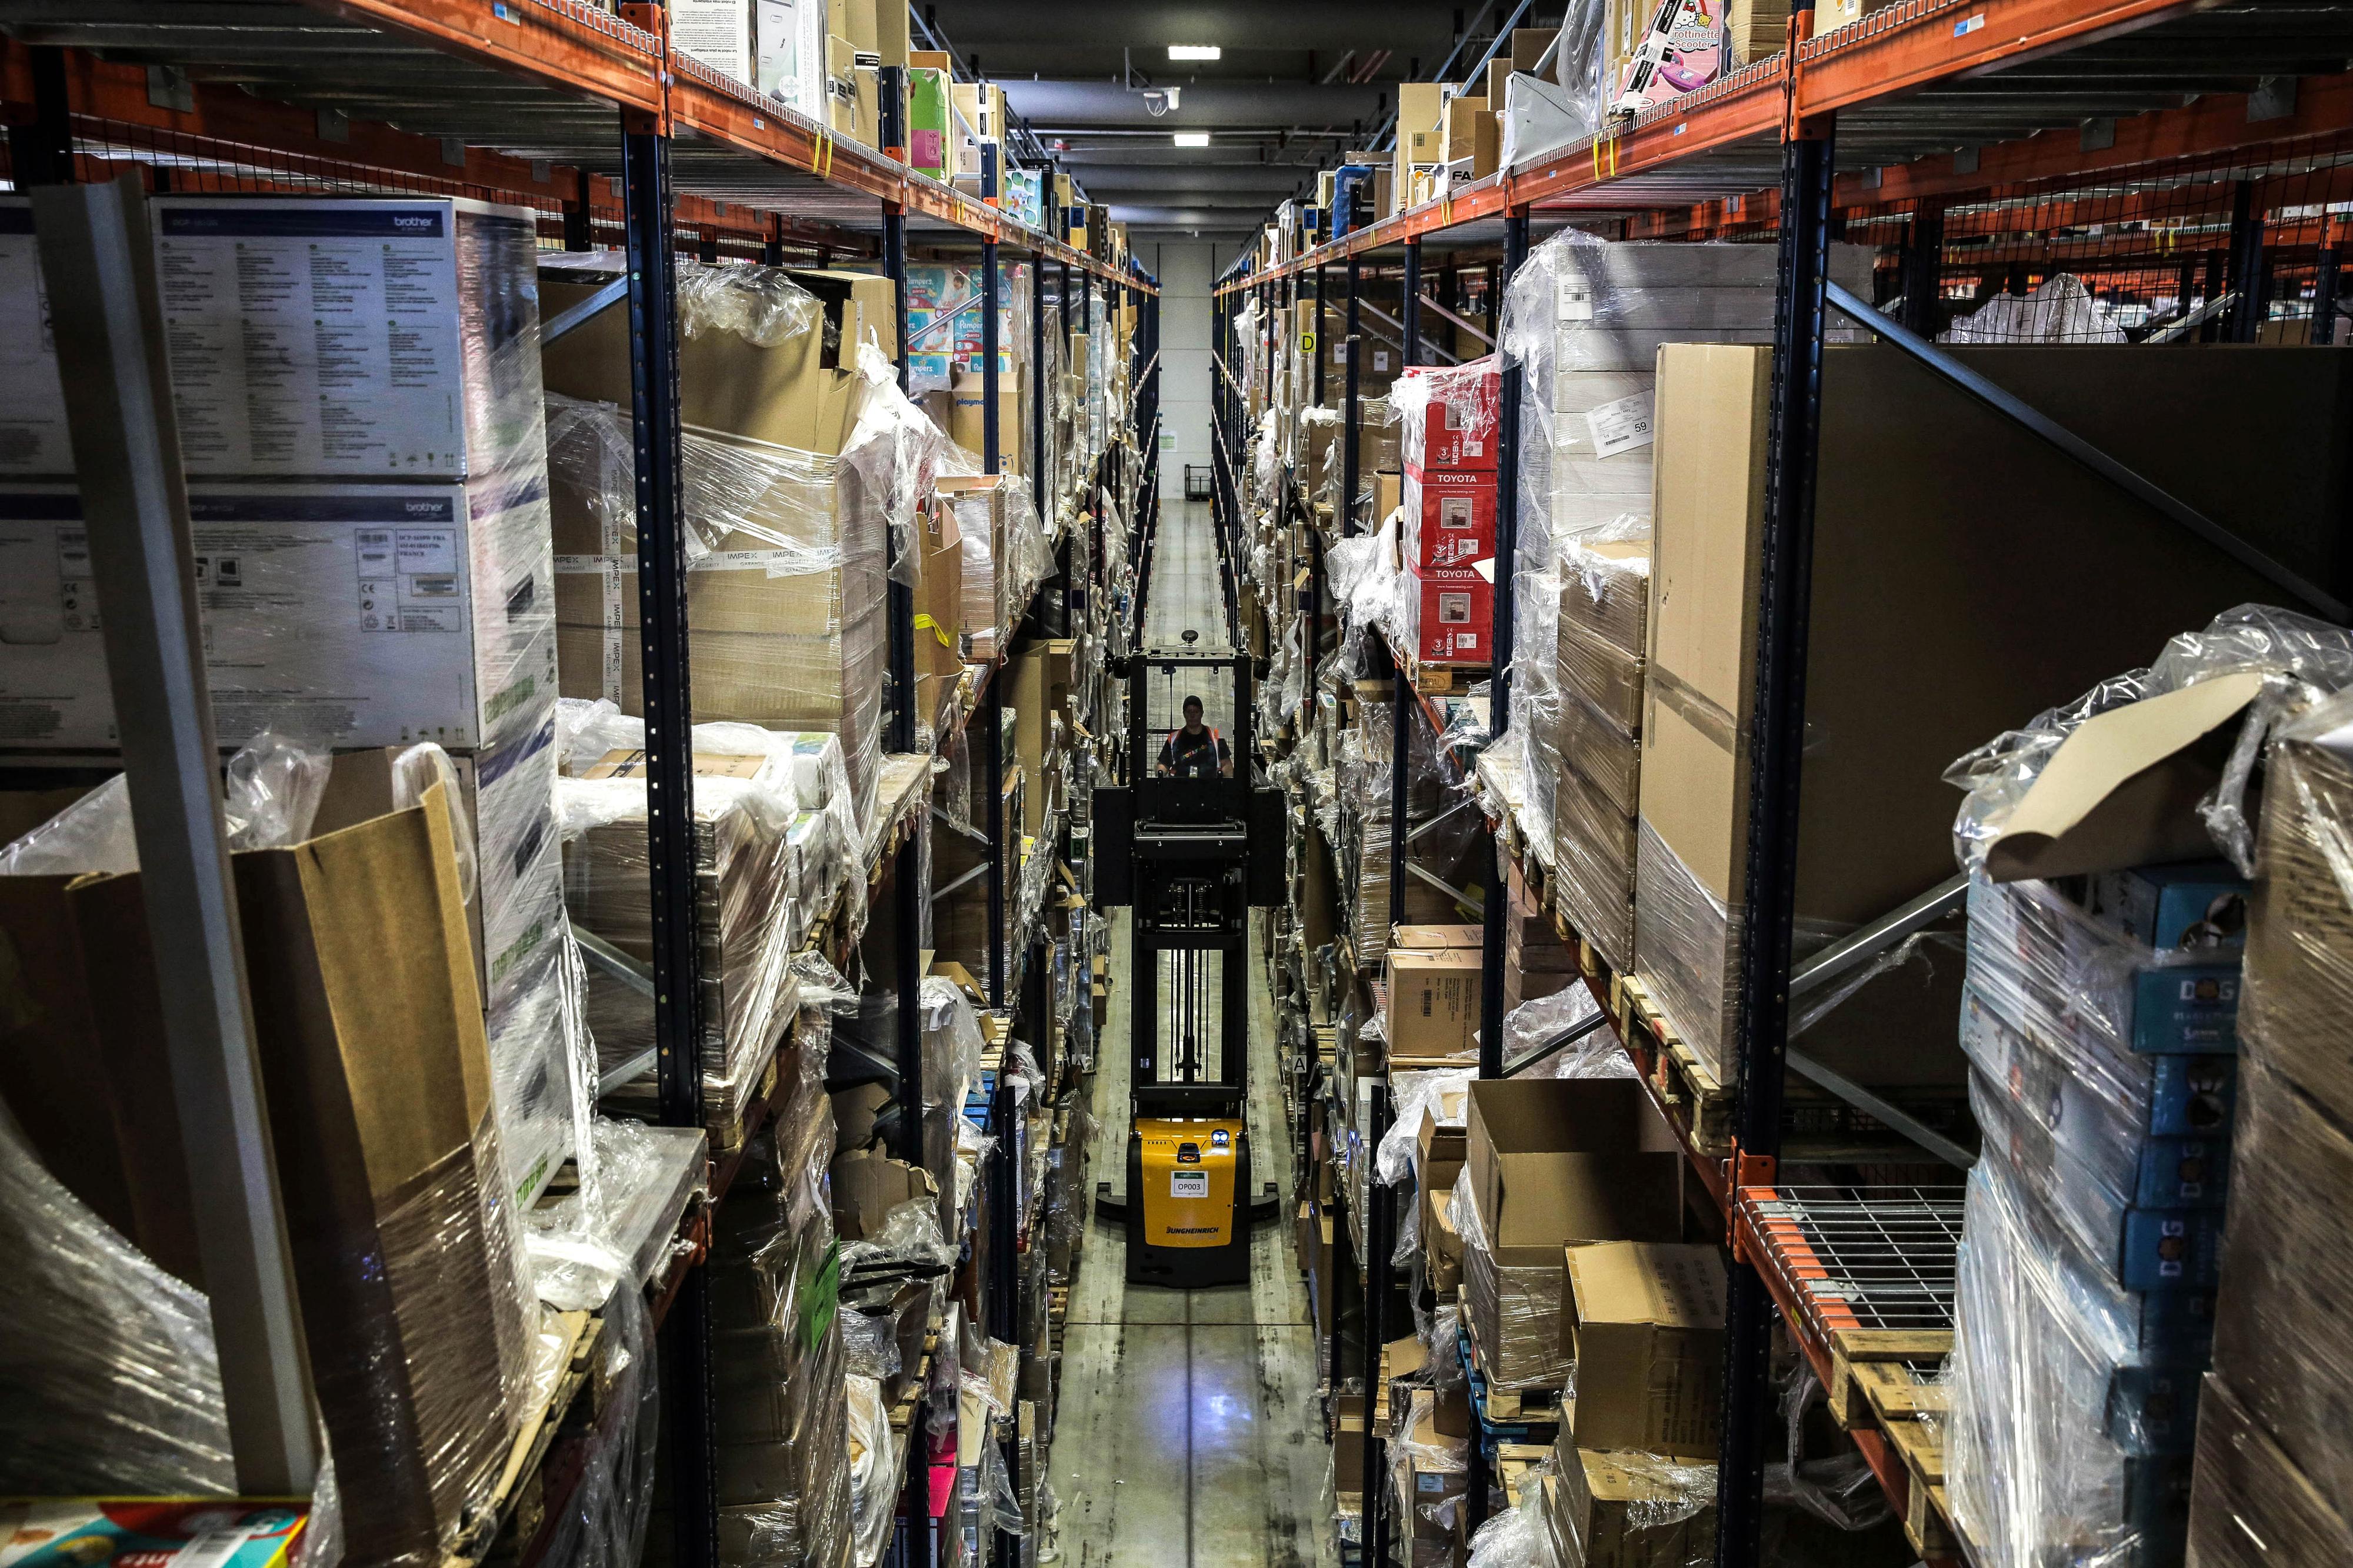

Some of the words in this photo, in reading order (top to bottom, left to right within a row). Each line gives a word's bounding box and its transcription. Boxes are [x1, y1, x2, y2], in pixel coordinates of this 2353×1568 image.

[1675, 39, 1711, 48] Scooter
[1452, 171, 1474, 181] FA
[395, 216, 433, 226] brother
[1074, 210, 1082, 225] E
[1307, 212, 1315, 228] E
[959, 320, 983, 330] Pamper
[1302, 335, 1314, 350] D
[1635, 422, 1647, 432] 59
[1437, 475, 1477, 483] TOYOTA
[405, 503, 443, 512] brother
[1074, 842, 1082, 855] B
[1166, 1226, 1219, 1234] JUNGHEINRICH
